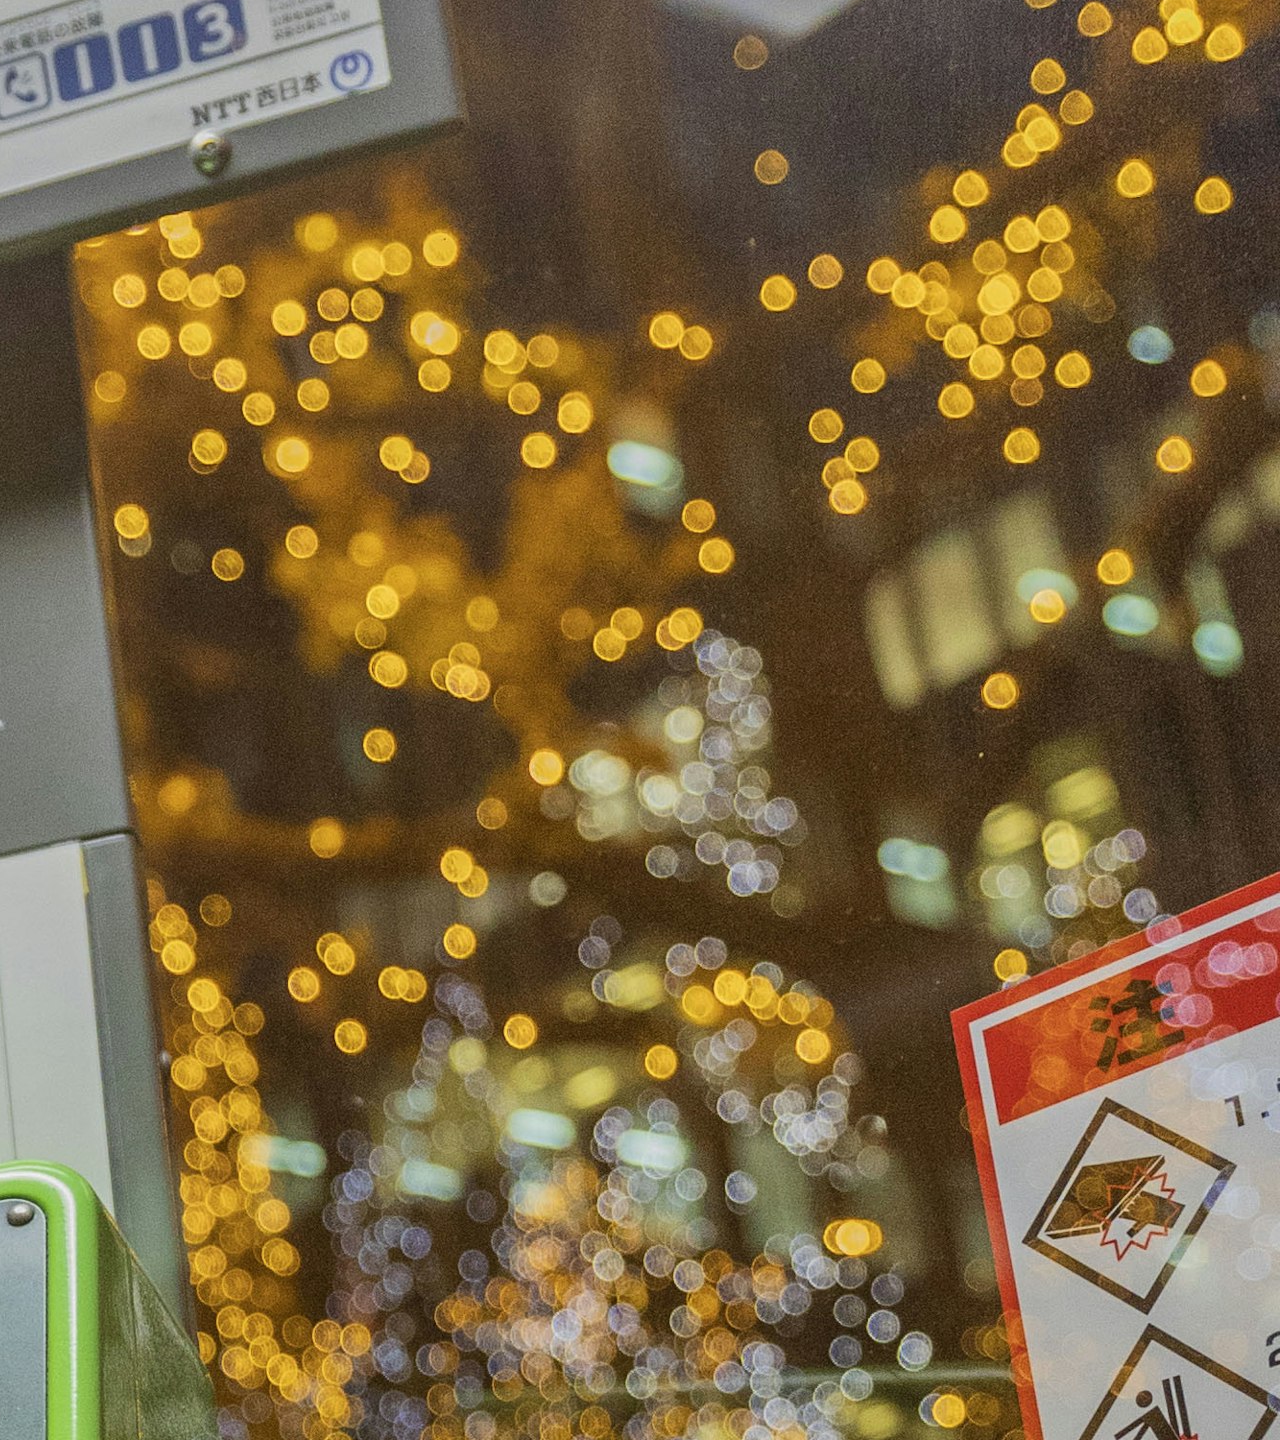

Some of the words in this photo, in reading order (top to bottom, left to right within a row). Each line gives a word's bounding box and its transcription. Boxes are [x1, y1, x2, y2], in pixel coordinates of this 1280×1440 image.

[77, 2, 233, 93] 113
[189, 71, 323, 127] NTT西日本
[1089, 979, 1185, 1073] 注
